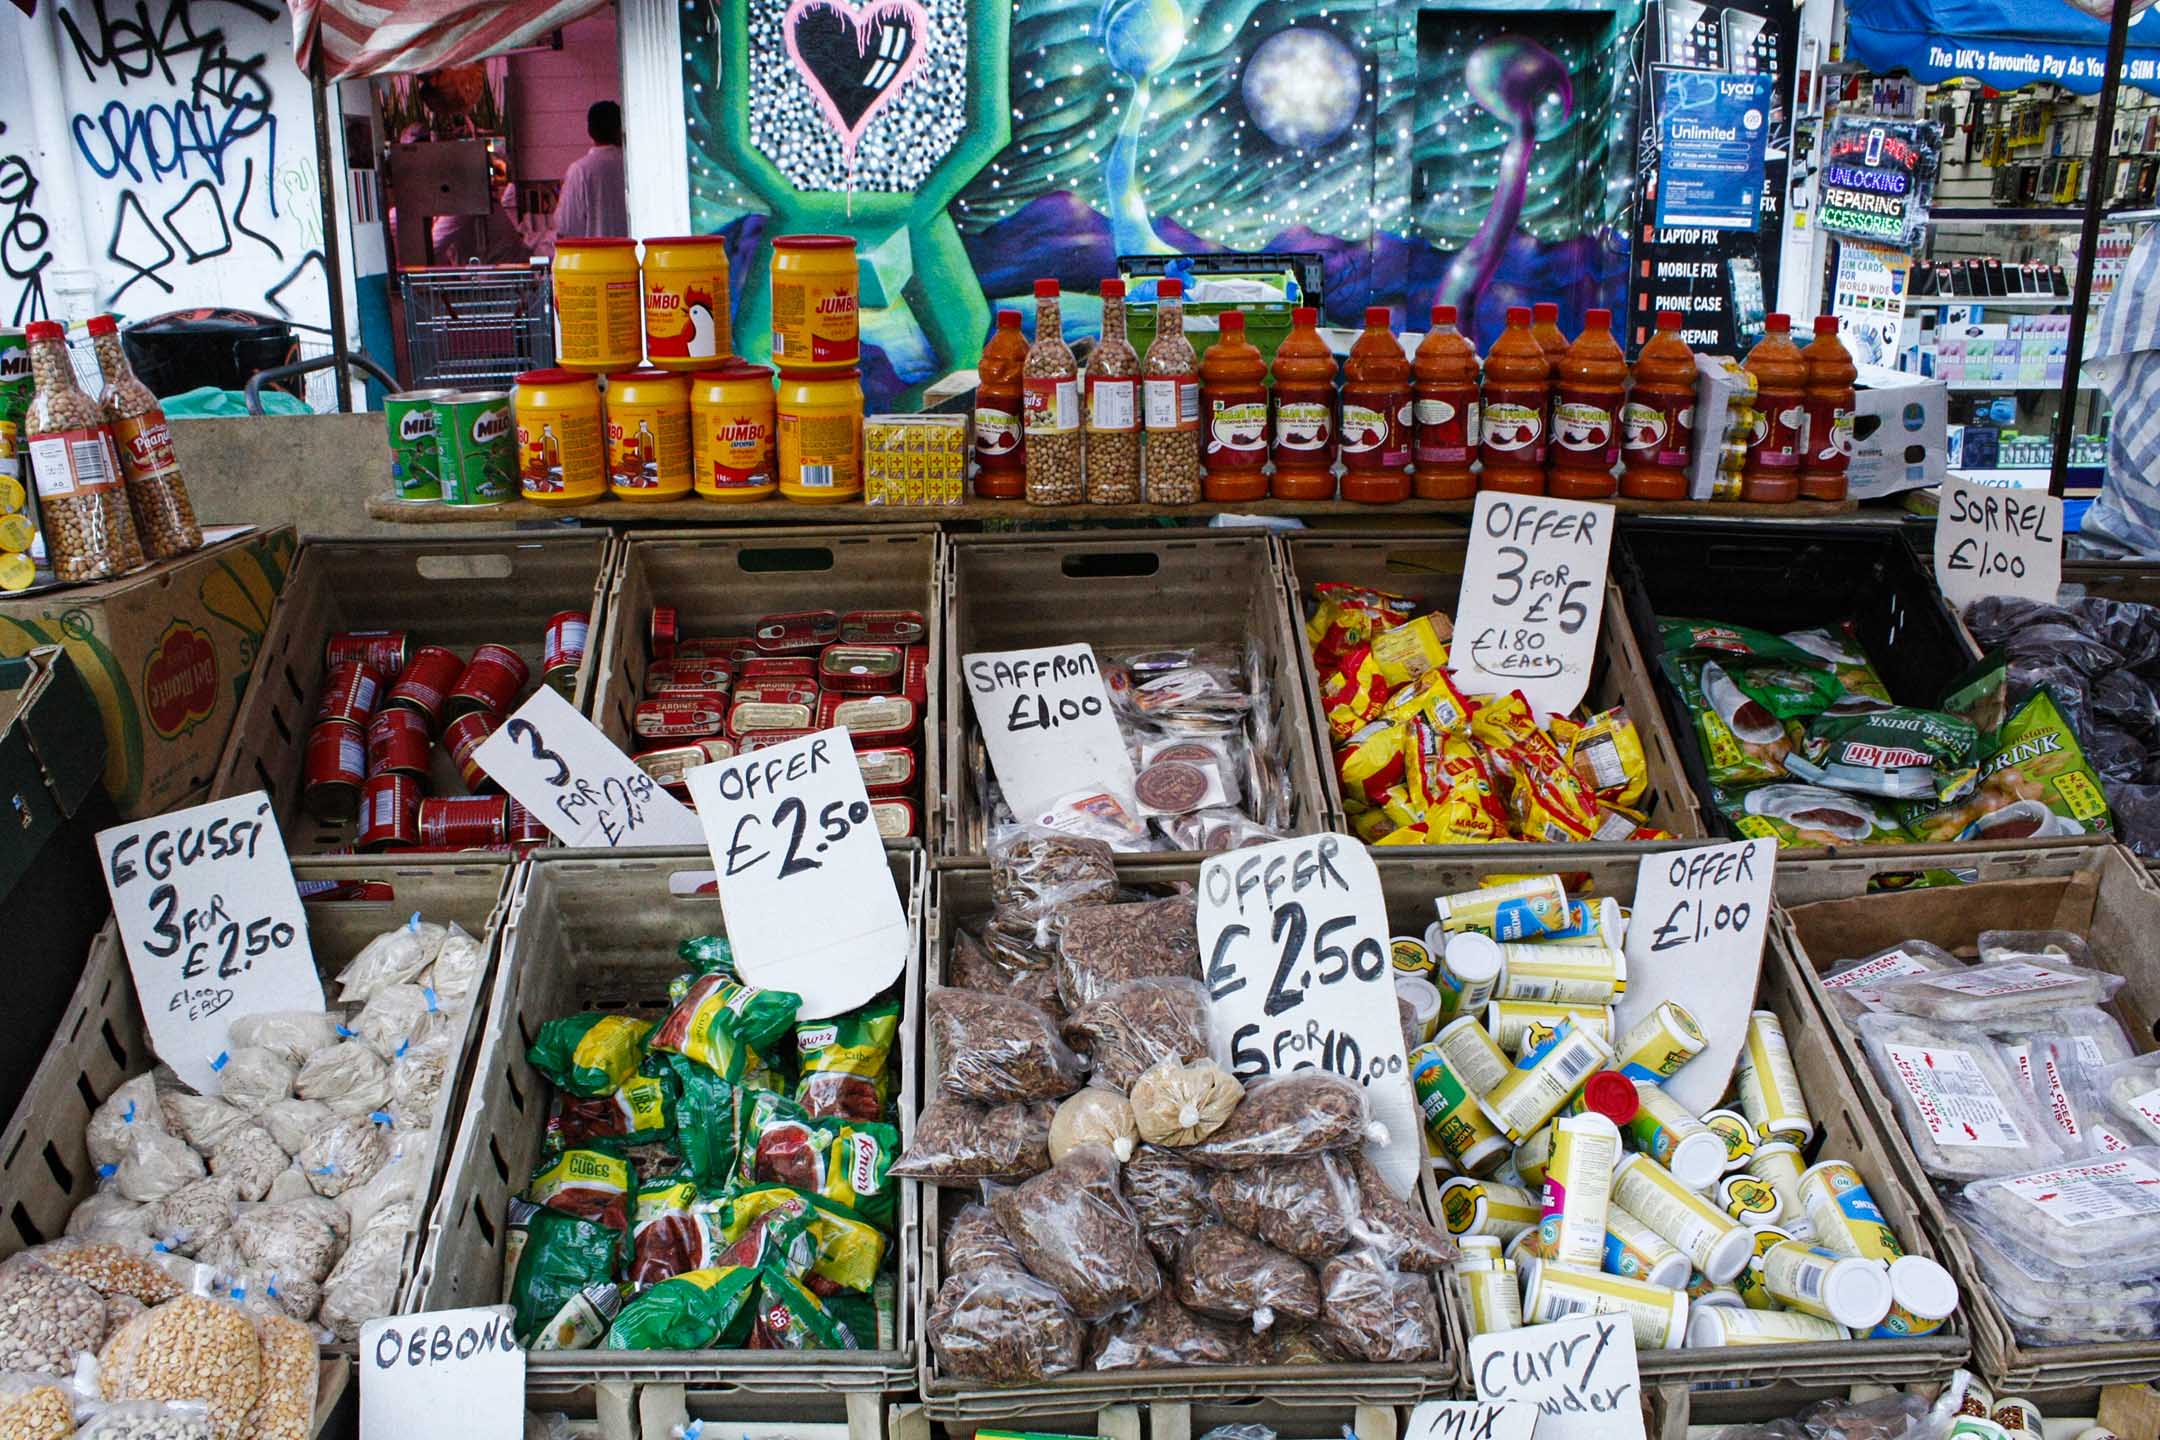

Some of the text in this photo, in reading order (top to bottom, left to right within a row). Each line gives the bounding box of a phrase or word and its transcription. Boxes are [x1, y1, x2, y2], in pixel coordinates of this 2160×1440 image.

[1929, 46, 1953, 68] The
[1955, 49, 1985, 70] UK's
[1988, 51, 2038, 73] favourite
[2042, 55, 2065, 79] Pay
[2067, 57, 2084, 75] As
[2130, 60, 2154, 80] SIM
[1720, 80, 1754, 96] Lyca
[1671, 125, 1736, 140] Unlimited
[1829, 167, 1905, 193] UNLOCKING
[1825, 189, 1901, 216] REPAIRING
[1660, 229, 1719, 245] LAPTOP FIX
[1817, 207, 1902, 235] ACCESSORIES
[1658, 262, 1718, 278] MOBILE FIX
[1840, 271, 1856, 280] FOR
[1841, 260, 1884, 273] SIM CARDS
[645, 294, 680, 311] UMBO
[1655, 296, 1722, 312] PHONE CASE
[1868, 284, 1890, 294] WIDE
[1681, 329, 1719, 344] REPAIR
[1, 358, 35, 377] MIL
[716, 425, 765, 443] JUMBO
[1486, 502, 1597, 545] OFFER
[1950, 490, 2052, 542] SORREL
[1948, 538, 2025, 578] £1.00
[1492, 546, 1570, 606] 3 FOR
[1523, 581, 1592, 635] £5
[1471, 628, 1545, 650] £1.80
[656, 703, 698, 711] SARDINES
[1008, 694, 1102, 733] £1.00
[507, 718, 570, 787] 3
[719, 739, 830, 800] OFFER
[556, 779, 601, 825] FOR
[726, 797, 869, 880] £2.50
[1455, 818, 1489, 832] MAGGI
[1205, 836, 1350, 916] OFFER
[1669, 842, 1756, 890] OFFER
[143, 883, 231, 957] 3 FOR
[1651, 899, 1751, 952] £1.00
[1204, 901, 1386, 1017] £2.50
[1823, 955, 1899, 988] BLUE OCEAN
[1869, 961, 1897, 975] FISH
[1231, 1019, 1402, 1088] 5 FOR 10.00
[2046, 1061, 2060, 1090] BLUE
[2056, 1093, 2077, 1135] OCEAN
[569, 1157, 610, 1178] CUBES
[856, 1137, 876, 1192] Knorr
[1536, 1383, 1631, 1415] wder
